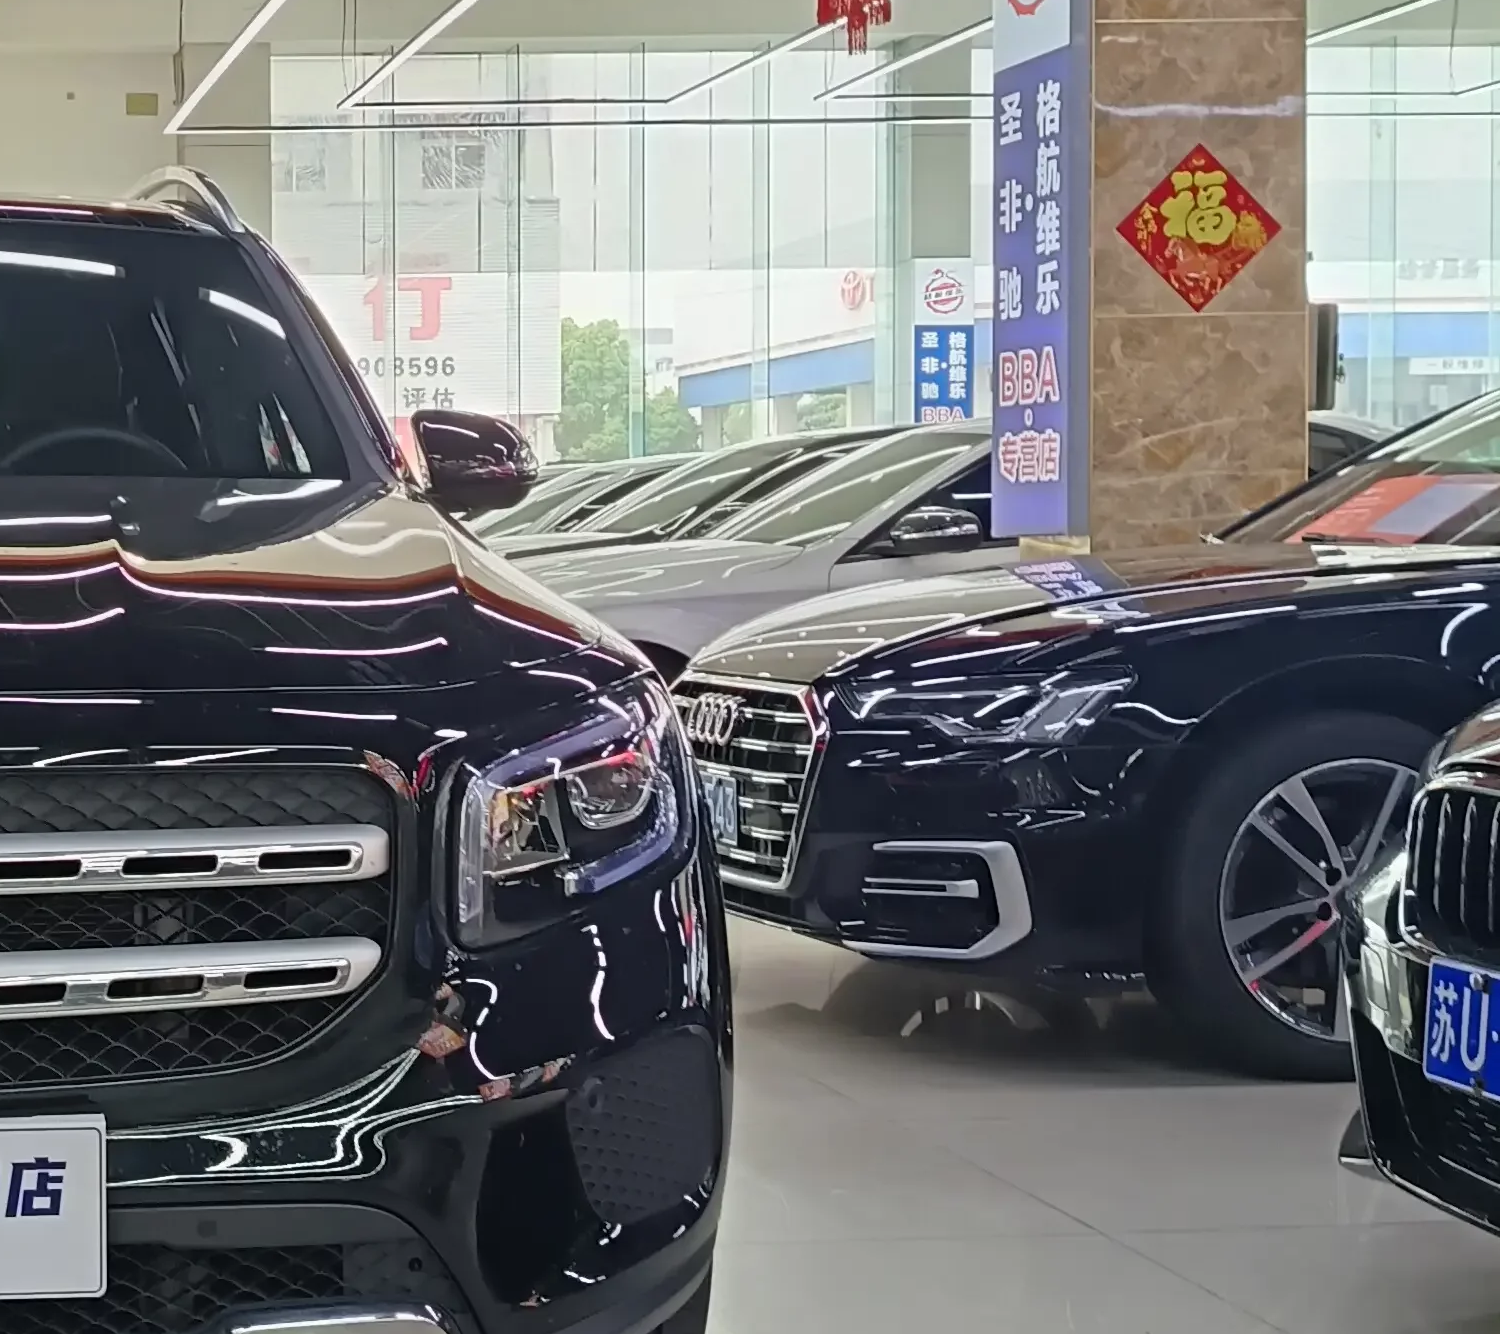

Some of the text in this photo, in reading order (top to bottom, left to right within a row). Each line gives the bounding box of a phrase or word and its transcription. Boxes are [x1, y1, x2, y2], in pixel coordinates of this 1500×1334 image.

[999, 91, 1022, 321] 圣非驰
[1035, 79, 1061, 315] 格航维乐
[1160, 170, 1237, 245] 福
[999, 345, 1060, 407] BBA
[921, 406, 965, 424] BBA
[999, 428, 1061, 483] 专营店
